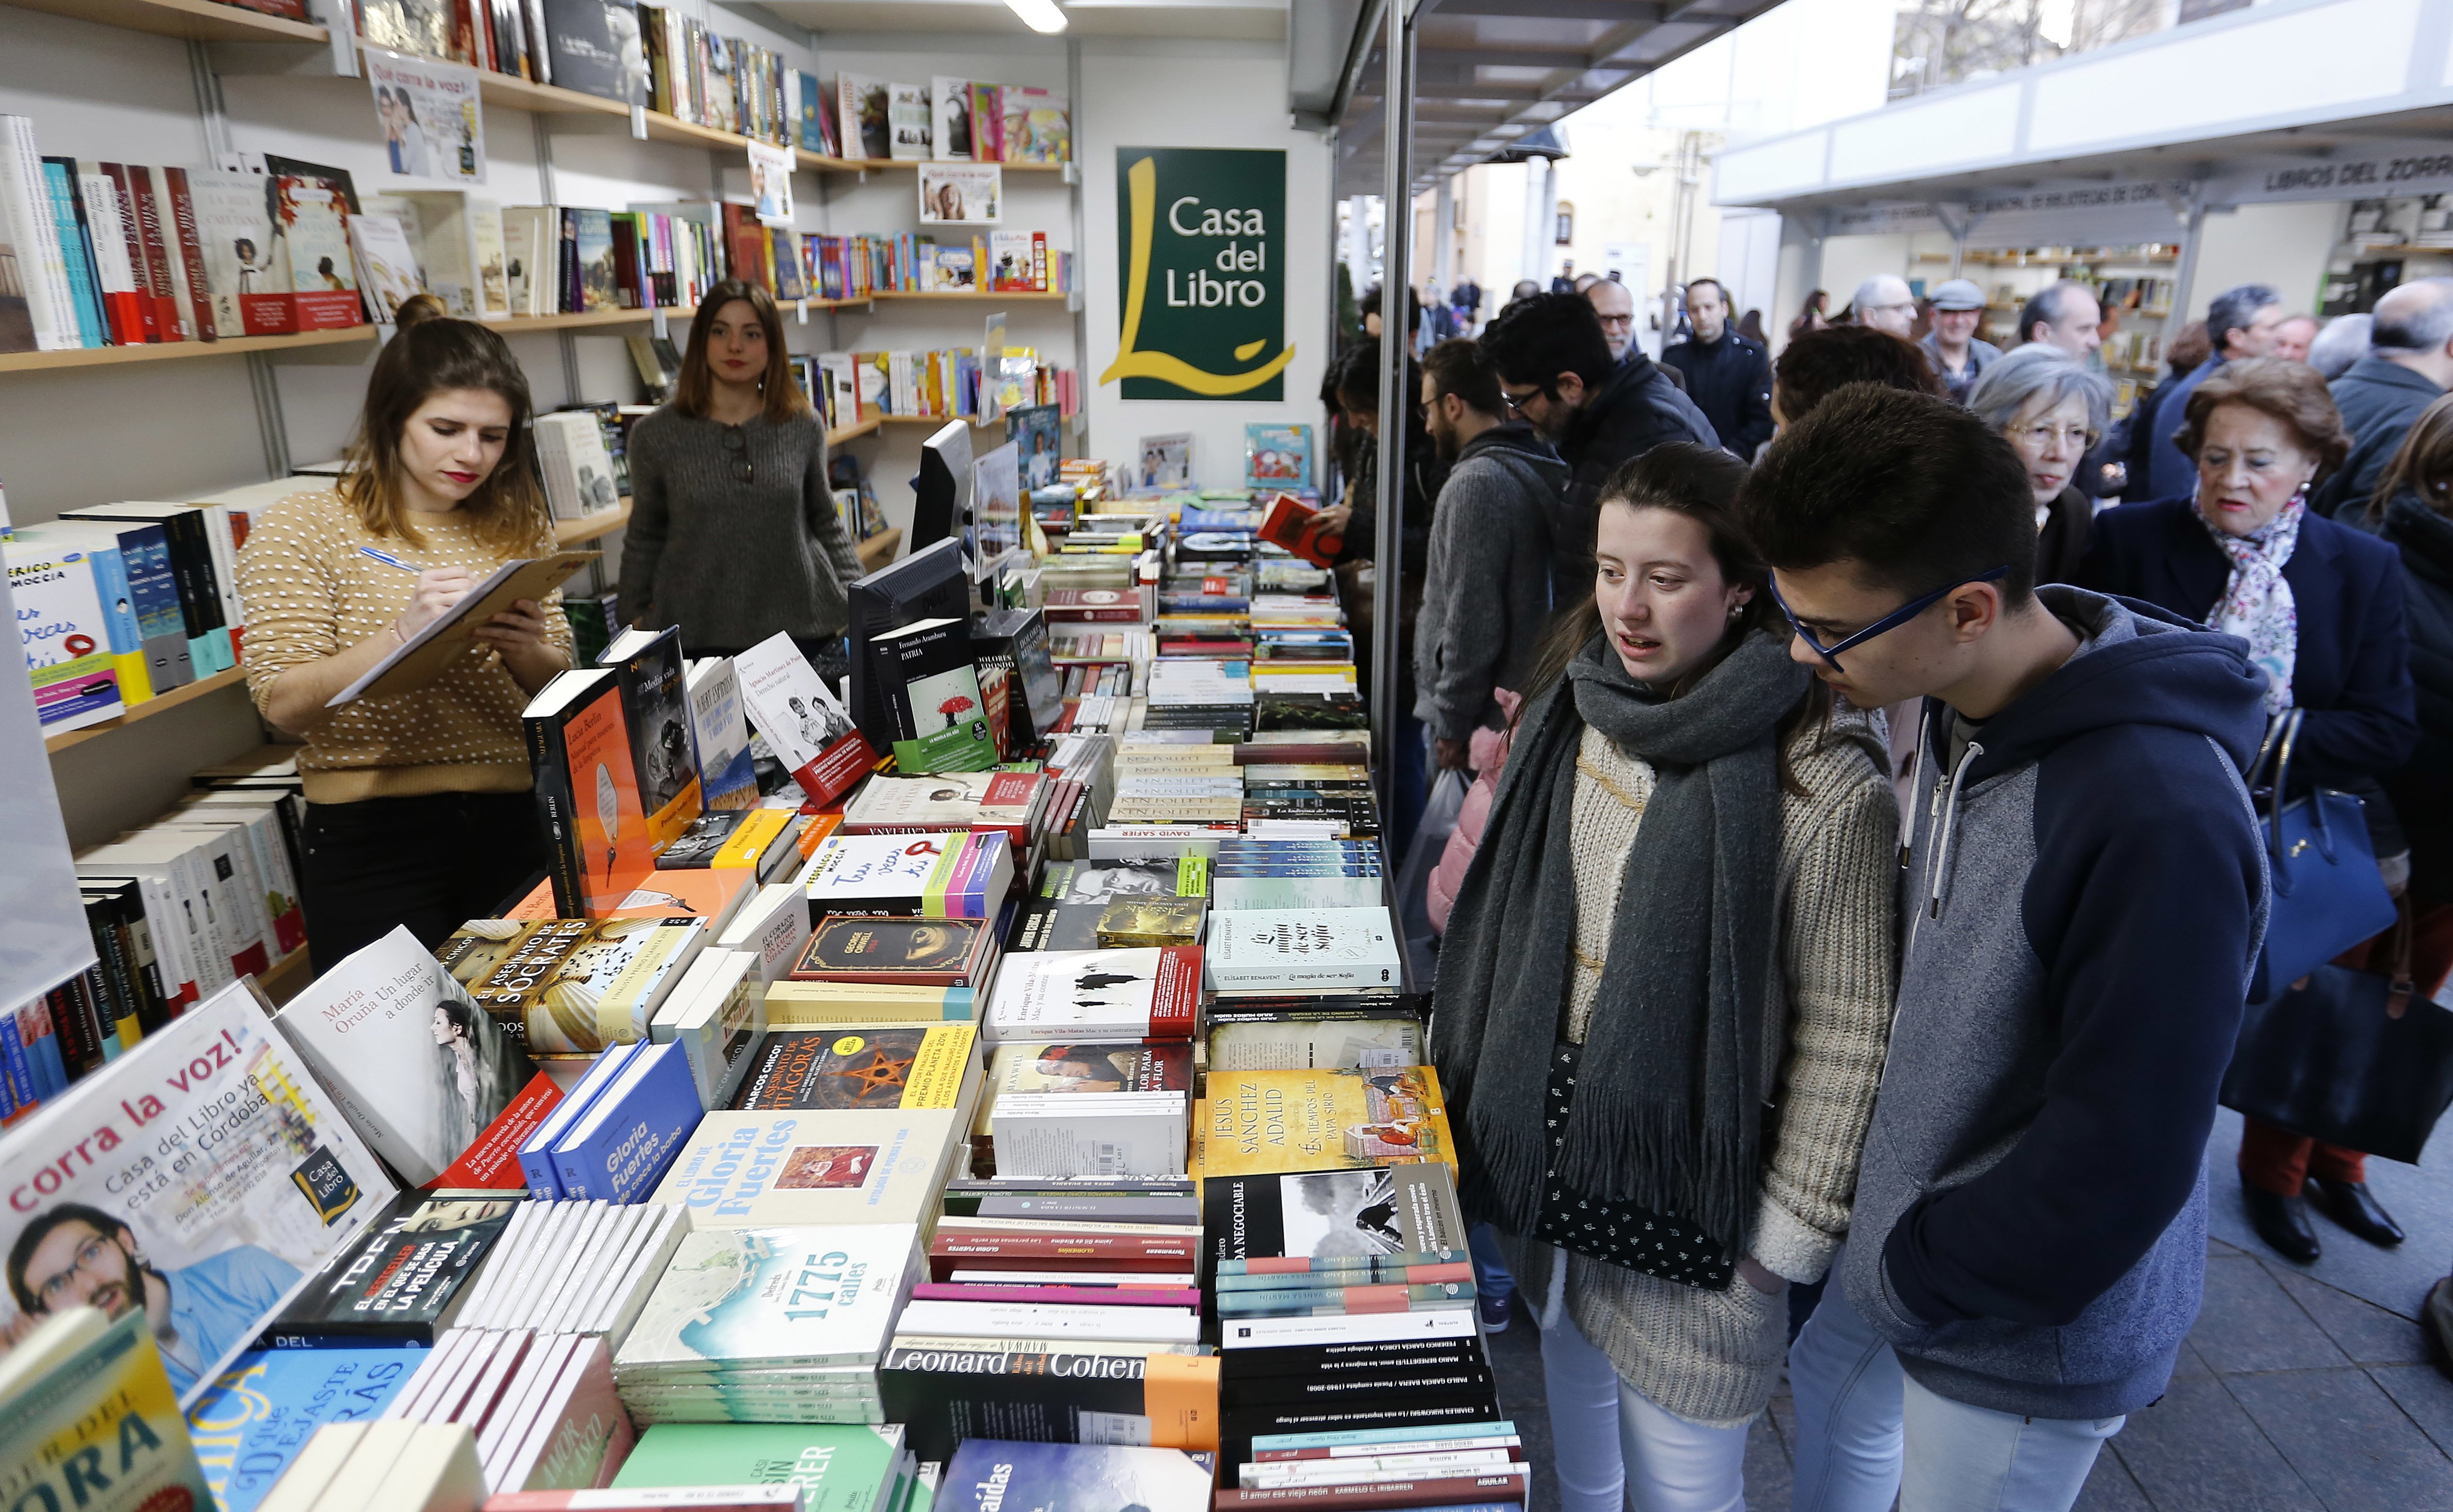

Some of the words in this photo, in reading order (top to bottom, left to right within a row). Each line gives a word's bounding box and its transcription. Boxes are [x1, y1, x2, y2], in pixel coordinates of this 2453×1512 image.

[1169, 195, 1266, 237] Casa
[1216, 240, 1266, 273] del
[1166, 268, 1267, 308] Libro
[10, 570, 65, 589] MOCCIA
[899, 638, 921, 650] Fernando
[921, 631, 947, 644] Aramburu
[901, 647, 923, 661] PATRIA
[643, 675, 664, 693] Media
[663, 666, 675, 682] vida
[749, 672, 767, 688] Ignacio
[766, 662, 786, 678] Martínez
[755, 682, 775, 697] Derecho
[774, 671, 791, 686] natural
[568, 725, 584, 746] Lucía
[584, 712, 602, 732] Berlin
[570, 741, 588, 763] Manual
[587, 734, 598, 751] para
[596, 722, 615, 745] mujeres
[583, 746, 602, 766] limpieza
[806, 853, 833, 885] FEDERICO
[826, 848, 847, 873] MOCCIA
[877, 847, 904, 876] veces
[762, 935, 770, 945] EL
[768, 911, 795, 937] CORAZÓN
[763, 939, 775, 952] DEL
[773, 920, 796, 943] HOMBRE
[844, 931, 864, 955] GEORGE
[854, 931, 874, 955] ORWELL
[1273, 923, 1294, 954] magia
[477, 988, 496, 1000] EL
[490, 936, 544, 986] ASESINATO
[537, 923, 558, 936] DE
[497, 921, 587, 1003] SÓCRATES
[321, 989, 365, 1023] María
[335, 1000, 379, 1034] Oruña
[375, 983, 397, 1001] Un
[394, 962, 423, 988] lugar
[386, 1010, 396, 1020] a
[395, 982, 425, 1011] donde
[422, 974, 435, 987] ir
[1110, 1026, 1147, 1035] contratiempo
[744, 1064, 770, 1111] MARCOS
[761, 1042, 784, 1073] CHICOT
[917, 1077, 932, 1107] PREMIO
[926, 1048, 942, 1077] PLANETA
[937, 1032, 948, 1047] 2016
[1007, 1053, 1024, 1091] MAXWELL
[1153, 1059, 1165, 1081] FLOR
[1212, 1098, 1237, 1139] JESÚS
[1237, 1083, 1259, 1154] SÁNCHEZ
[1265, 1088, 1285, 1146] ADALID
[1322, 1092, 1337, 1116] SIRIO
[9, 1126, 124, 1213] corra
[121, 1094, 167, 1127] la
[166, 1028, 242, 1093] voz!
[105, 1154, 155, 1194] Casa
[157, 1124, 189, 1156] del
[189, 1088, 236, 1132] Libro
[237, 1072, 261, 1097] ya
[466, 1156, 477, 1169] La
[475, 1141, 493, 1161] nueva
[491, 1123, 510, 1144] novela
[507, 1116, 516, 1126] de
[512, 1110, 521, 1119] la
[519, 1096, 535, 1114] autora
[1324, 1116, 1338, 1141] PAPA
[127, 1169, 172, 1210] está
[173, 1150, 198, 1173] en
[198, 1091, 270, 1151] Córdoba
[606, 1120, 649, 1173] Gloria
[309, 1159, 334, 1183] Casa
[326, 1166, 339, 1181] del
[611, 1132, 660, 1194] Fuertes
[686, 1126, 759, 1208] Gloria
[714, 1119, 798, 1217] Fuertes
[318, 1174, 344, 1199] Libro
[1432, 1189, 1444, 1210] invierno
[1232, 1181, 1246, 1249] NEGOCIABLE
[1427, 1217, 1437, 1241] Landero
[412, 1241, 437, 1261] BASA
[1442, 1238, 1449, 1247] El
[391, 1271, 412, 1287] QUE
[392, 1294, 418, 1310] LA
[405, 1240, 459, 1292] PELÍCULA
[405, 1261, 421, 1271] SE
[383, 1288, 400, 1298] EL
[783, 1251, 849, 1322] 1775
[837, 1262, 868, 1307] calles
[353, 1298, 374, 1310] EL
[373, 1299, 391, 1310] EN
[276, 1336, 313, 1348] DEL
[997, 1340, 1048, 1353] MARWAN
[881, 1348, 1009, 1375] Leonard
[1050, 1354, 1146, 1380] Cohen
[236, 1361, 359, 1491] DEJASTE
[750, 1457, 769, 1478] CASI
[1240, 1491, 1248, 1500] El
[1249, 1491, 1272, 1500] amor
[1287, 1489, 1307, 1500] viejo
[1308, 1487, 1330, 1497] neón
[1335, 1485, 1368, 1495] KARMELO
[1368, 1485, 1377, 1493] C.
[1378, 1483, 1414, 1493] IRIBARREN
[1477, 1476, 1509, 1487] AGUILAR
